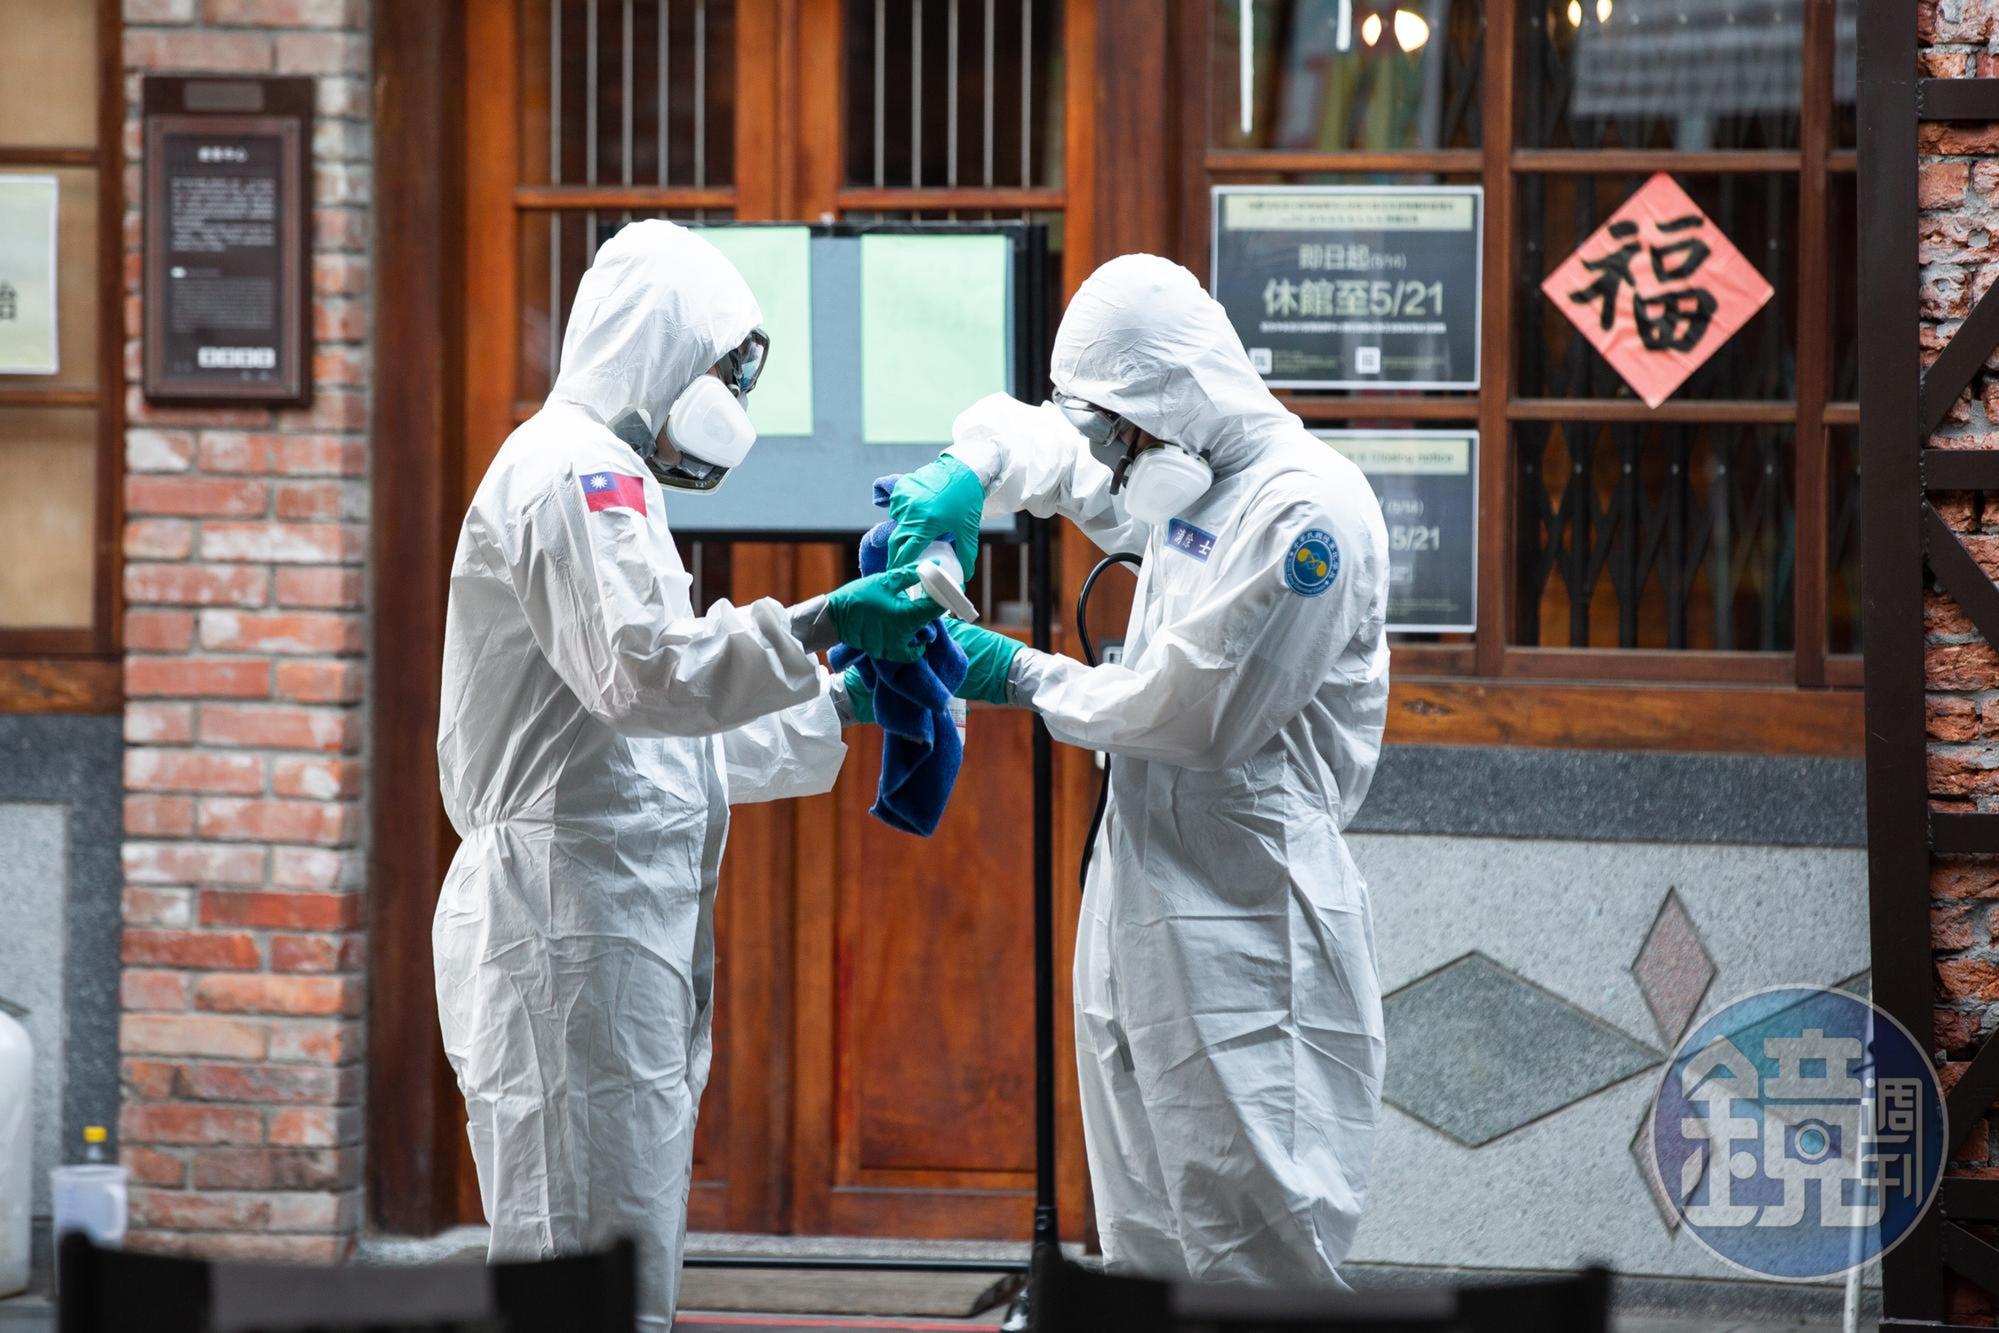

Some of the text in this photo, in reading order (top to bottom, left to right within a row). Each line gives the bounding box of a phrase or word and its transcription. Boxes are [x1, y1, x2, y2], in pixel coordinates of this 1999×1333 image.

[1262, 278, 1444, 317] 休館至5/21
[1568, 214, 1719, 352] 福
[1391, 525, 1441, 551] 5/21
